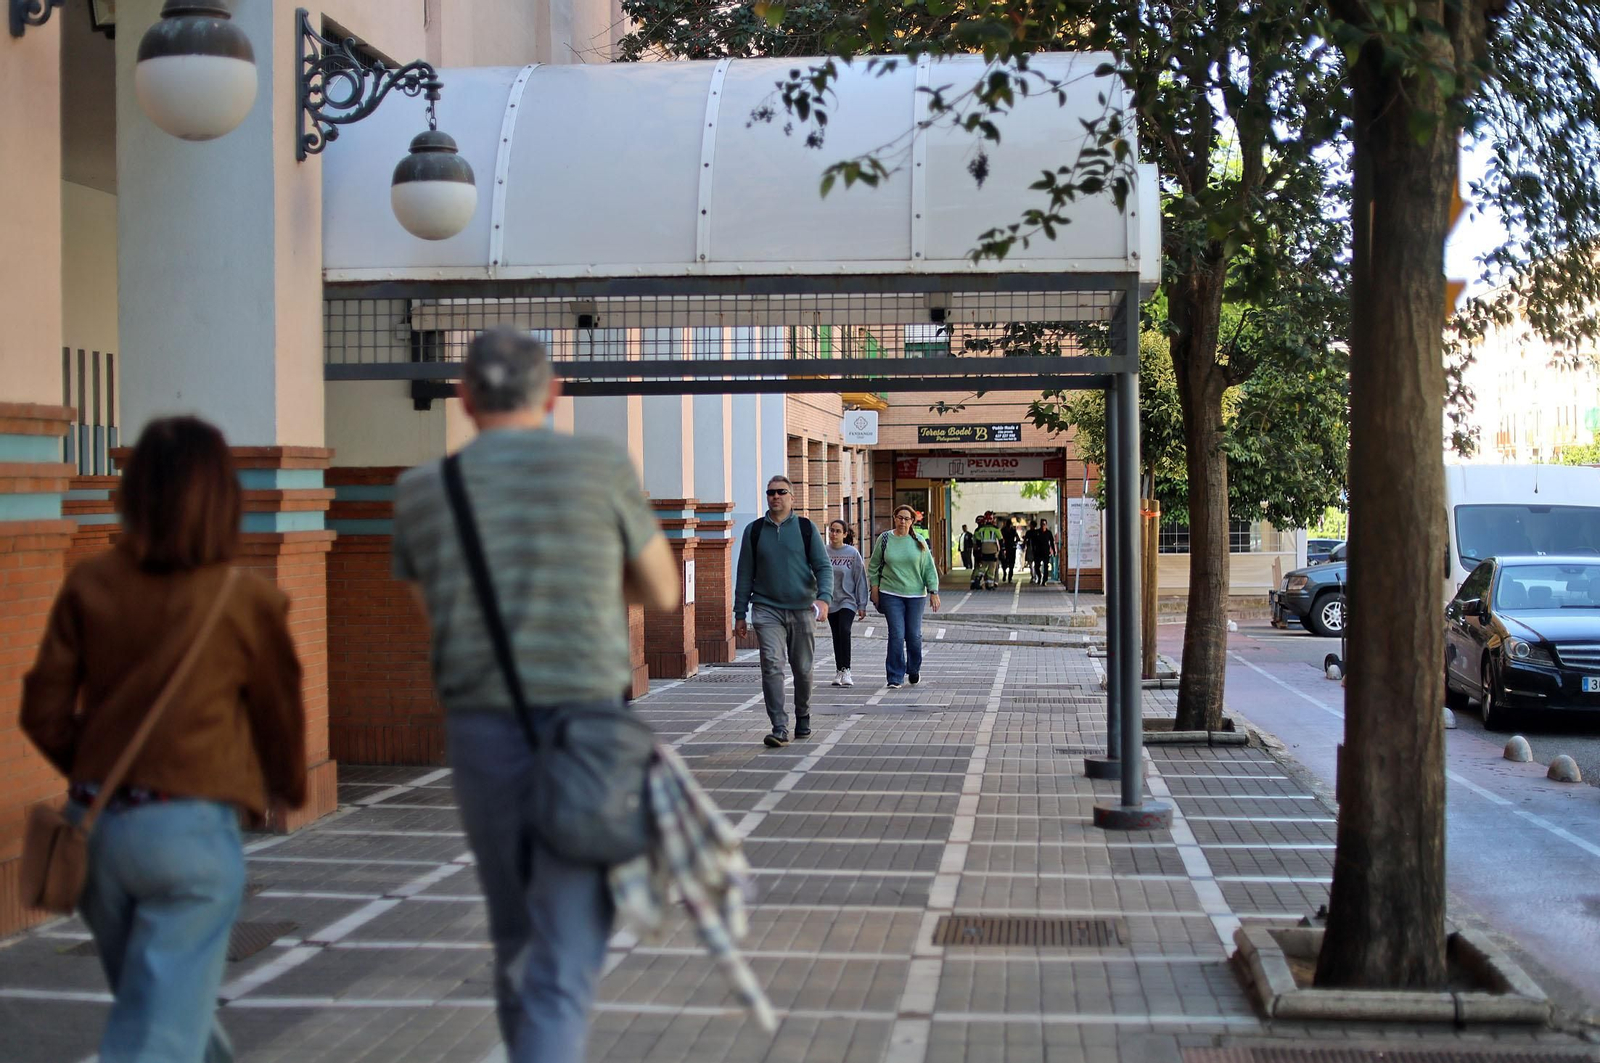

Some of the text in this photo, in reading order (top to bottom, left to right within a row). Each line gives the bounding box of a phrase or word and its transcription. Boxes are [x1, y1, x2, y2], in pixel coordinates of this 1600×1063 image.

[920, 426, 973, 437] Teresa Bodel
[967, 458, 1019, 468] PEVARO
[1591, 678, 1600, 691] 3
